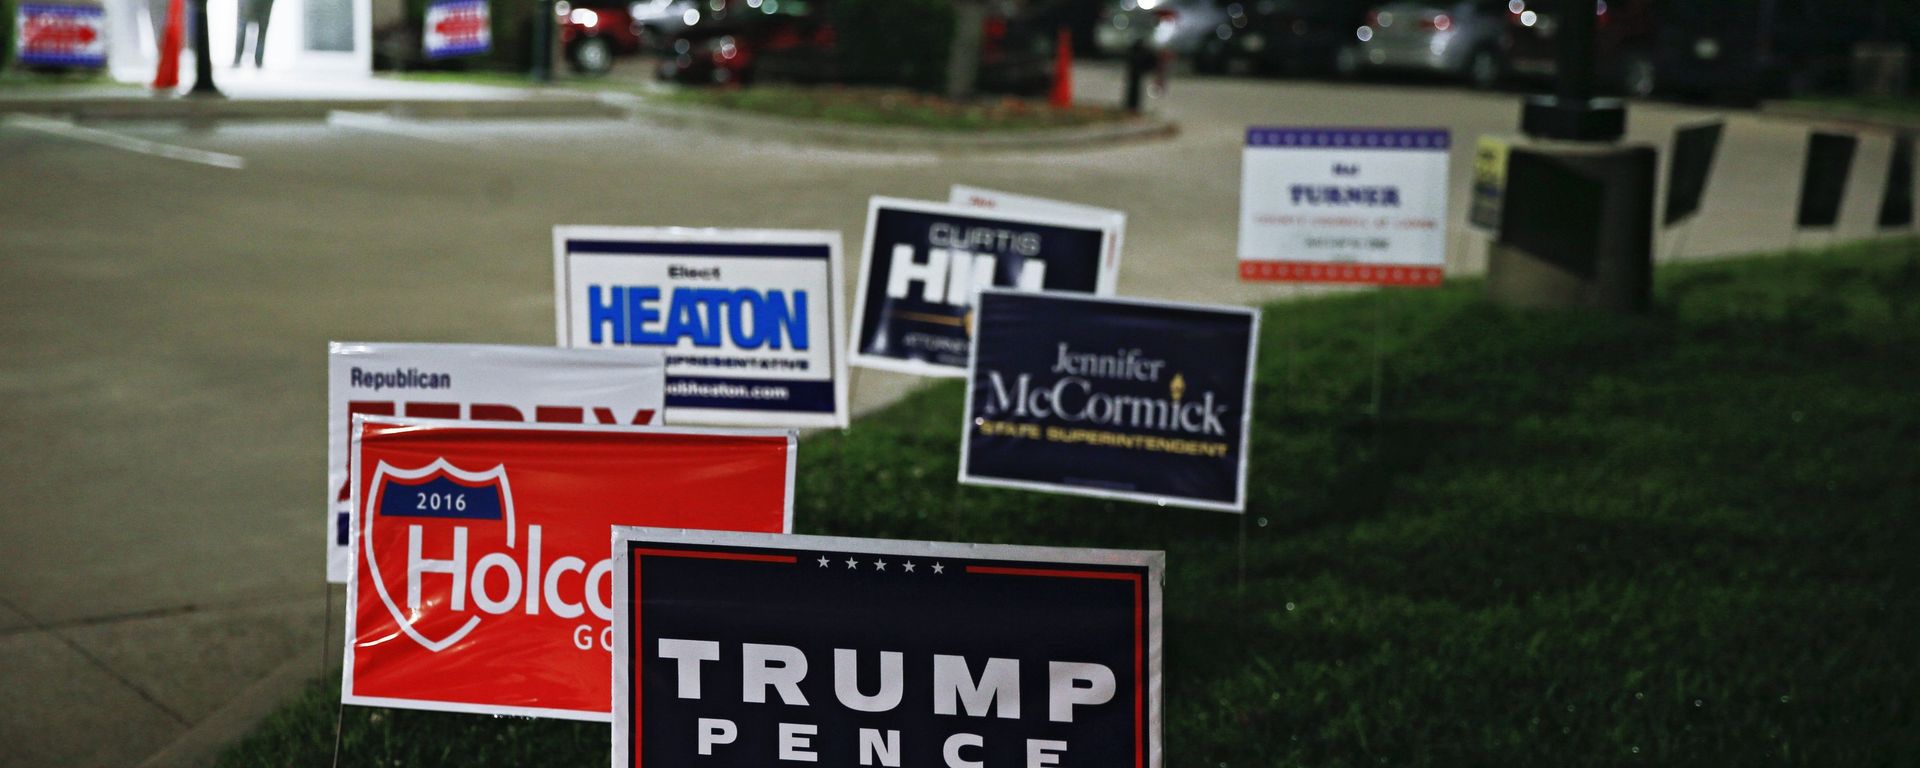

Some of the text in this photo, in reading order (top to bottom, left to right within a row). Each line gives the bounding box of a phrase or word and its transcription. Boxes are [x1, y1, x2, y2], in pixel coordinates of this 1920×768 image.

[1289, 184, 1400, 207] TURNER
[928, 222, 1042, 256] CURTIS
[668, 265, 721, 281] Elect
[588, 285, 809, 351] HEATON
[351, 367, 451, 391] Republican
[1052, 341, 1166, 382] Jennifer
[984, 369, 1228, 436] McCormick
[979, 419, 1228, 457] STATE SUPERINTENDENT
[416, 491, 466, 512] 2016
[658, 637, 1117, 723] TRUMP
[698, 717, 1068, 768] PENCE
